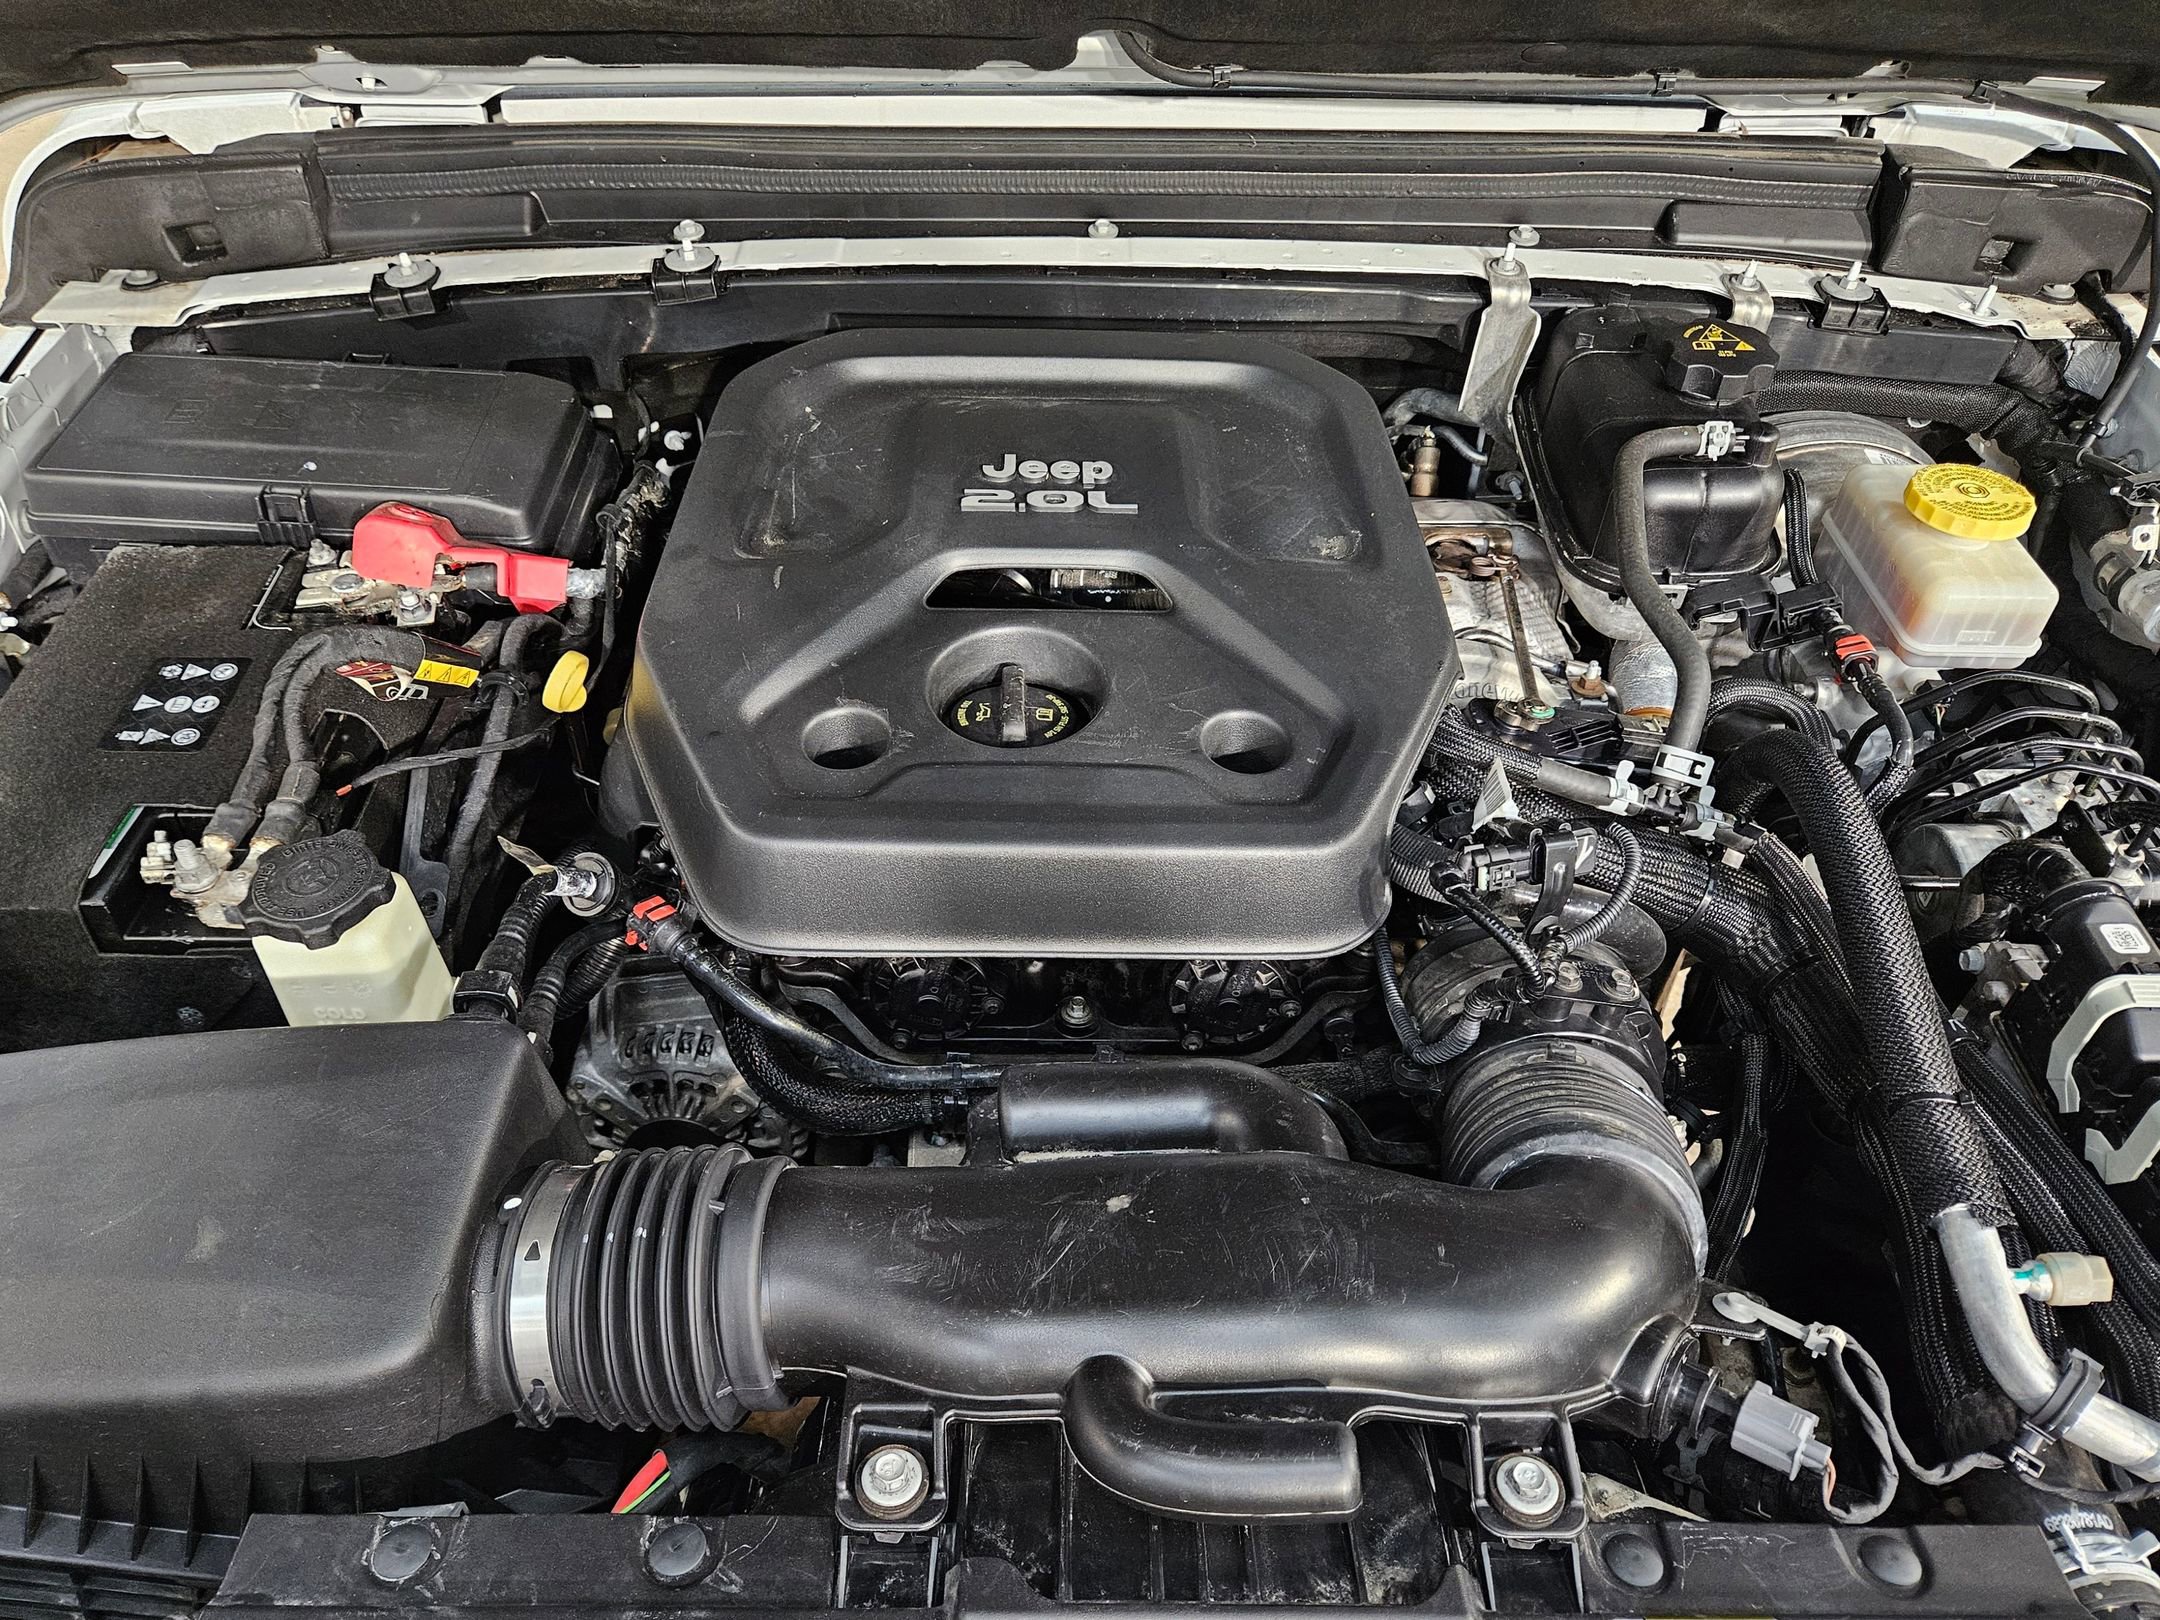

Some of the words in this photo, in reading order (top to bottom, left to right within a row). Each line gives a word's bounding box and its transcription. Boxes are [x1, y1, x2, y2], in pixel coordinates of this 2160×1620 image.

[981, 453, 1114, 489] Jeep
[960, 488, 1139, 515] 2.0L
[278, 907, 305, 917] USE
[313, 1006, 366, 1020] COLD
